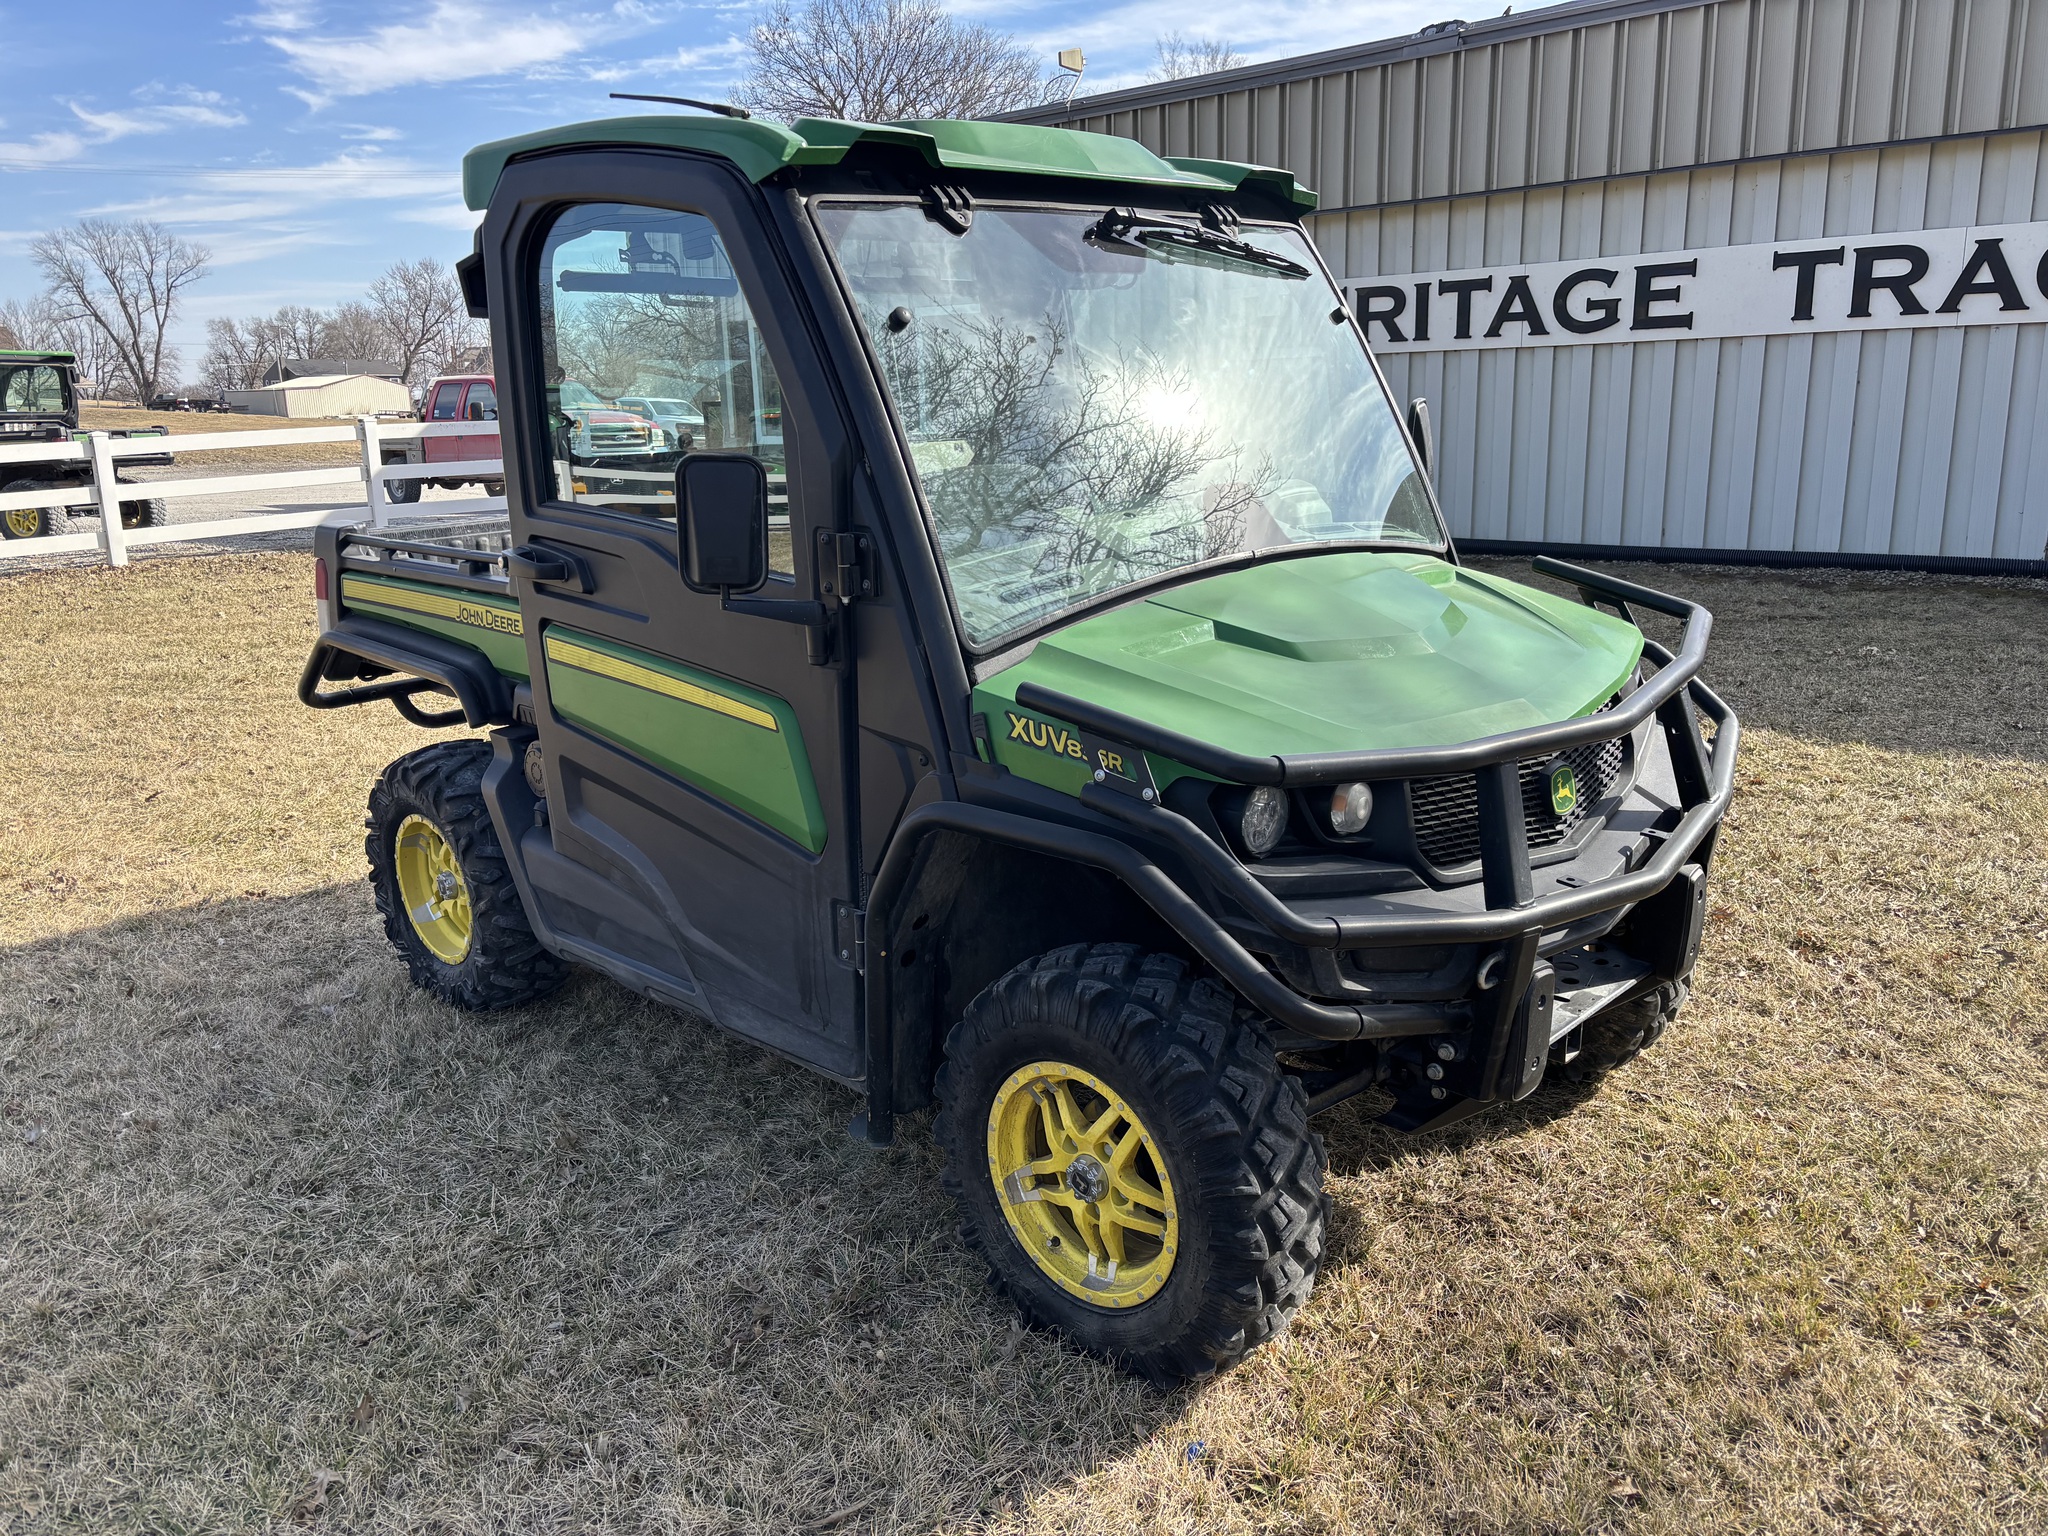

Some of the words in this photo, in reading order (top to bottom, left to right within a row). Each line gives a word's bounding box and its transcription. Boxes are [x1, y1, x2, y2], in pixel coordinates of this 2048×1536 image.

[1340, 257, 1698, 343] RITAGE
[1773, 237, 2048, 321] TRA
[456, 604, 484, 627] JOHN
[485, 609, 520, 633] DEERE
